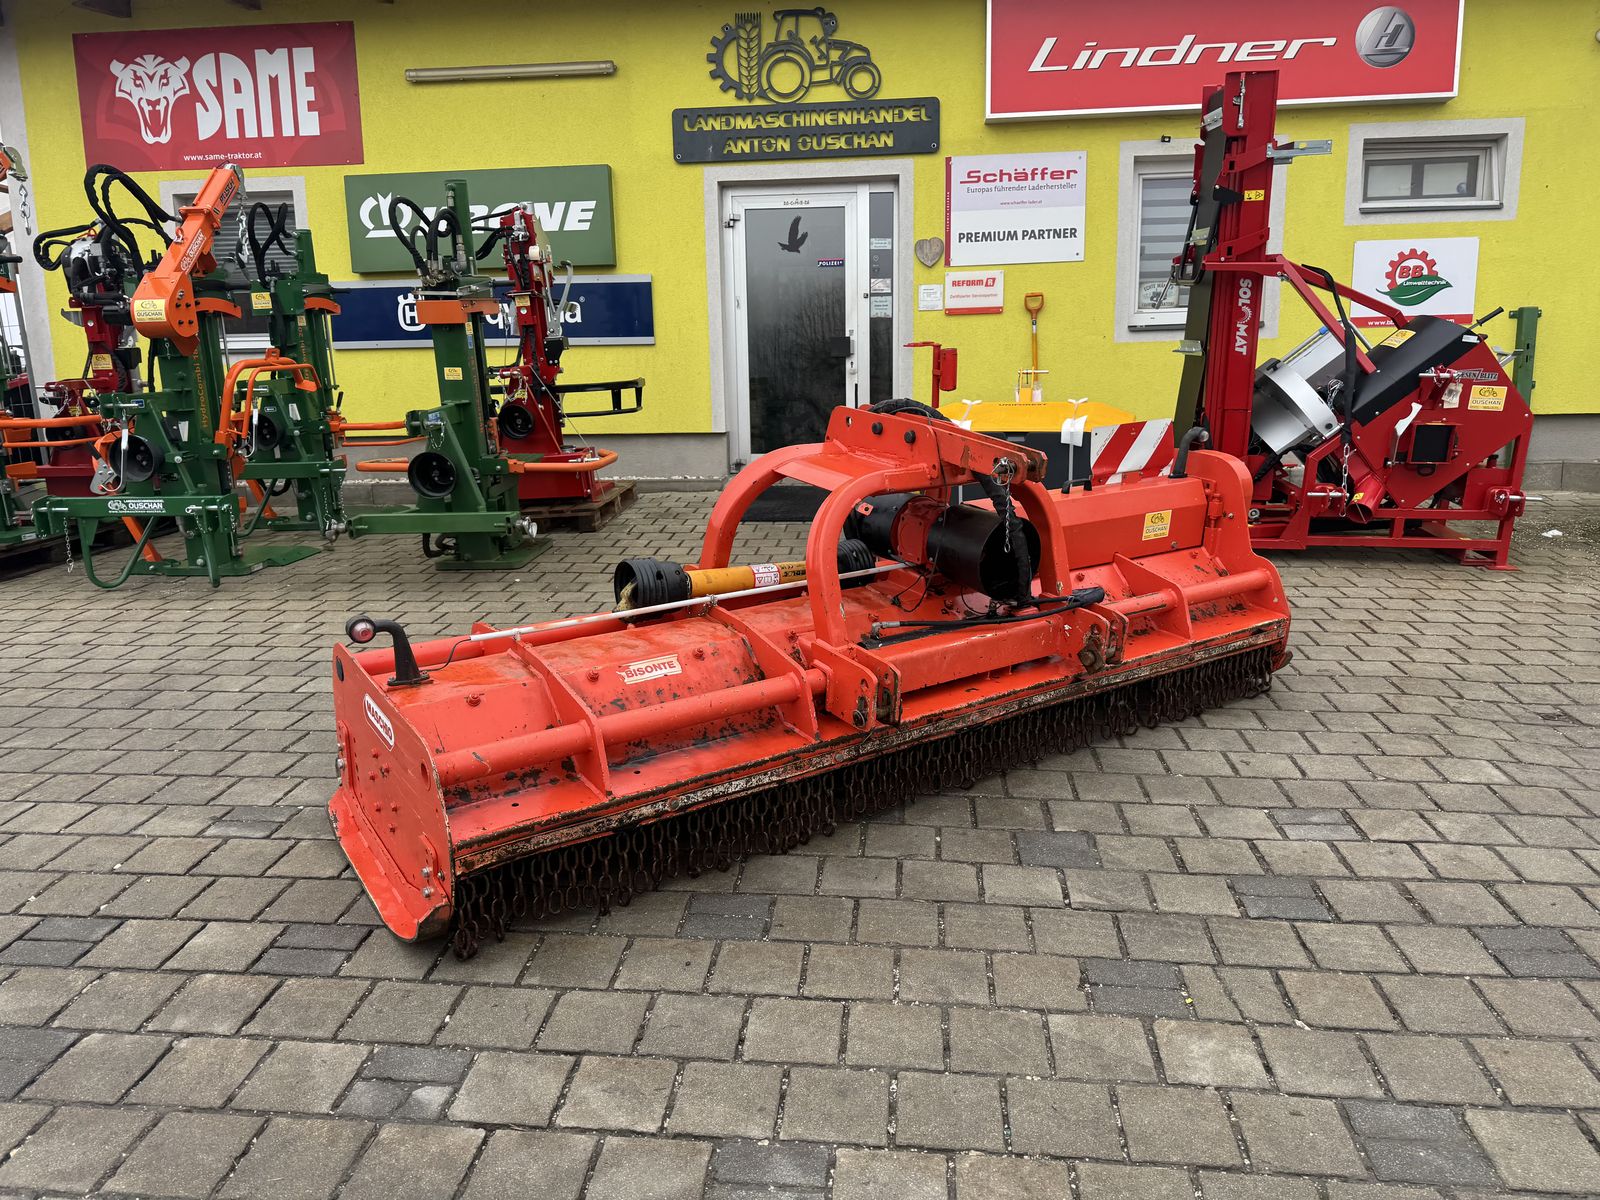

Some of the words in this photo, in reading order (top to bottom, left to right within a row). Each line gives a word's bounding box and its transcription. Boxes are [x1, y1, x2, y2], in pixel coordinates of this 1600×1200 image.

[1027, 34, 1337, 73] Lindner
[192, 47, 321, 142] SAME
[682, 105, 932, 132] LANDMASCHINENHANDEL
[723, 135, 791, 154] ANTON
[797, 131, 894, 151] OUSCHAN
[183, 151, 263, 161] www.same-traktor.at
[960, 167, 1078, 184] Schäffer
[966, 185, 993, 194] Europas
[994, 184, 1027, 192] führender
[1028, 182, 1077, 191] Laderhersteller
[958, 230, 1019, 243] PREMIUM
[1021, 227, 1078, 241] PARTNER
[1398, 265, 1425, 278] BB
[951, 279, 984, 287] REFORM
[624, 660, 677, 679] BISONTE
